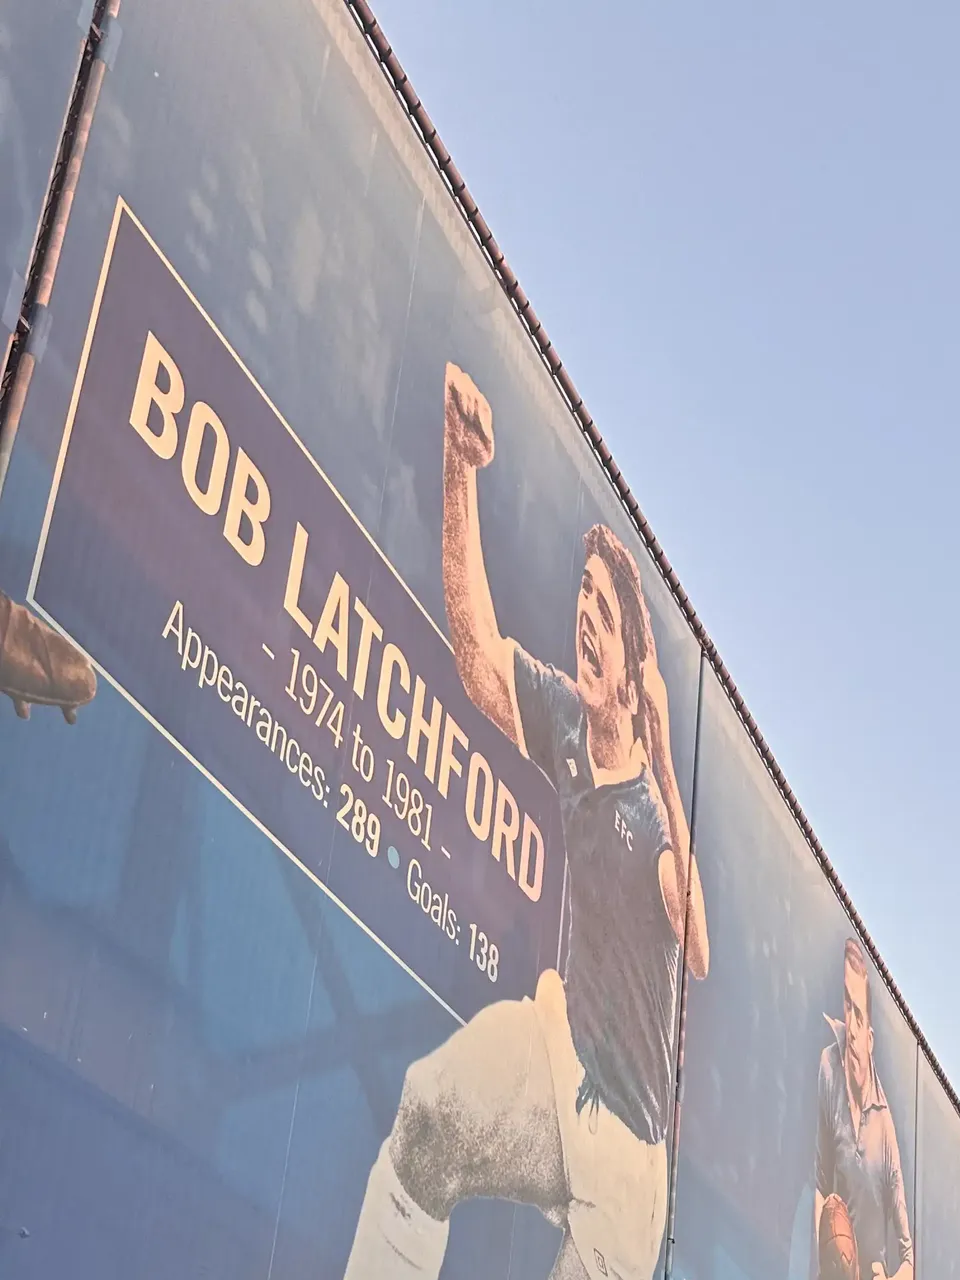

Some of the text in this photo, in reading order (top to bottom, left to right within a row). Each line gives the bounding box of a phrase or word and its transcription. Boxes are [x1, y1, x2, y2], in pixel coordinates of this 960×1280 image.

[130, 331, 546, 903] BOB LATCHFORD
[284, 661, 344, 747] 1974
[353, 720, 376, 780] to
[383, 759, 433, 856] 1981
[162, 600, 500, 984] Appearances: 289 Goals: 138
[615, 810, 633, 851] EFC
